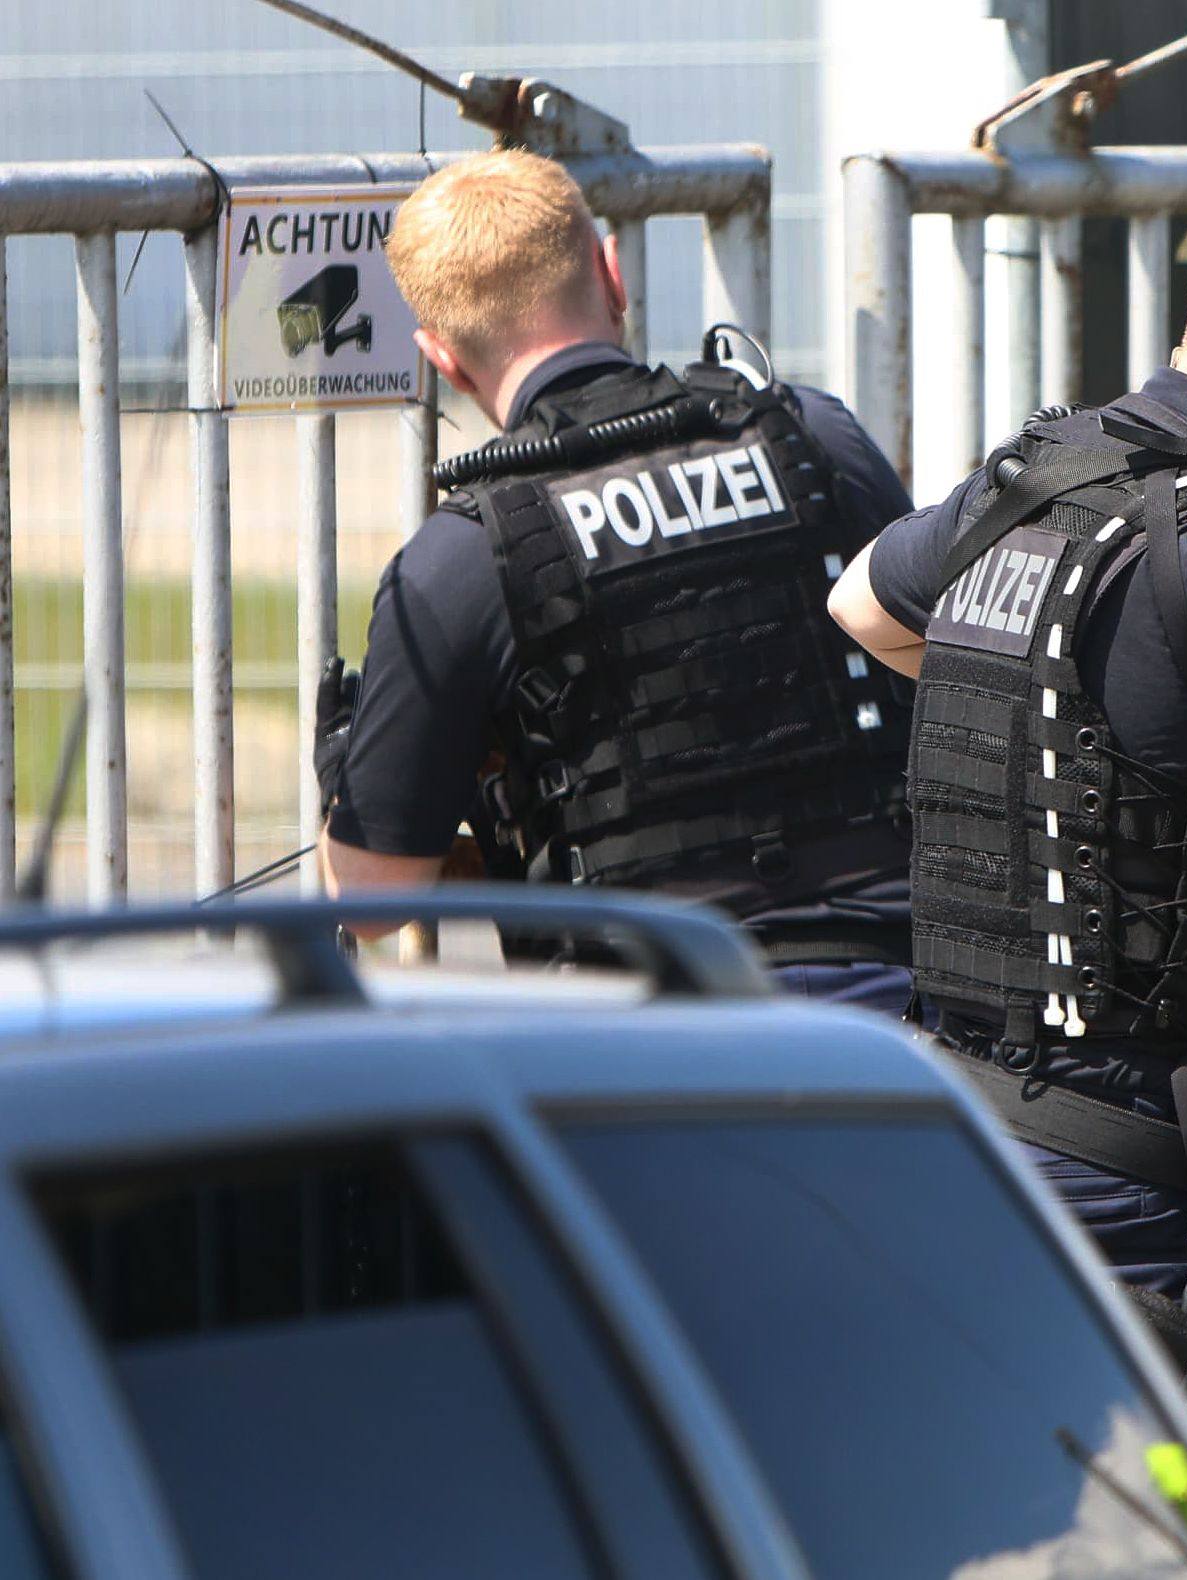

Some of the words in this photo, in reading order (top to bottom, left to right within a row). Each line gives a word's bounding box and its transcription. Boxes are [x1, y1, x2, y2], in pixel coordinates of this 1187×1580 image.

[239, 208, 392, 256] ACHTUN
[234, 371, 411, 399] VIDEOÜBERWACHUNG
[560, 443, 786, 560] POLIZEI
